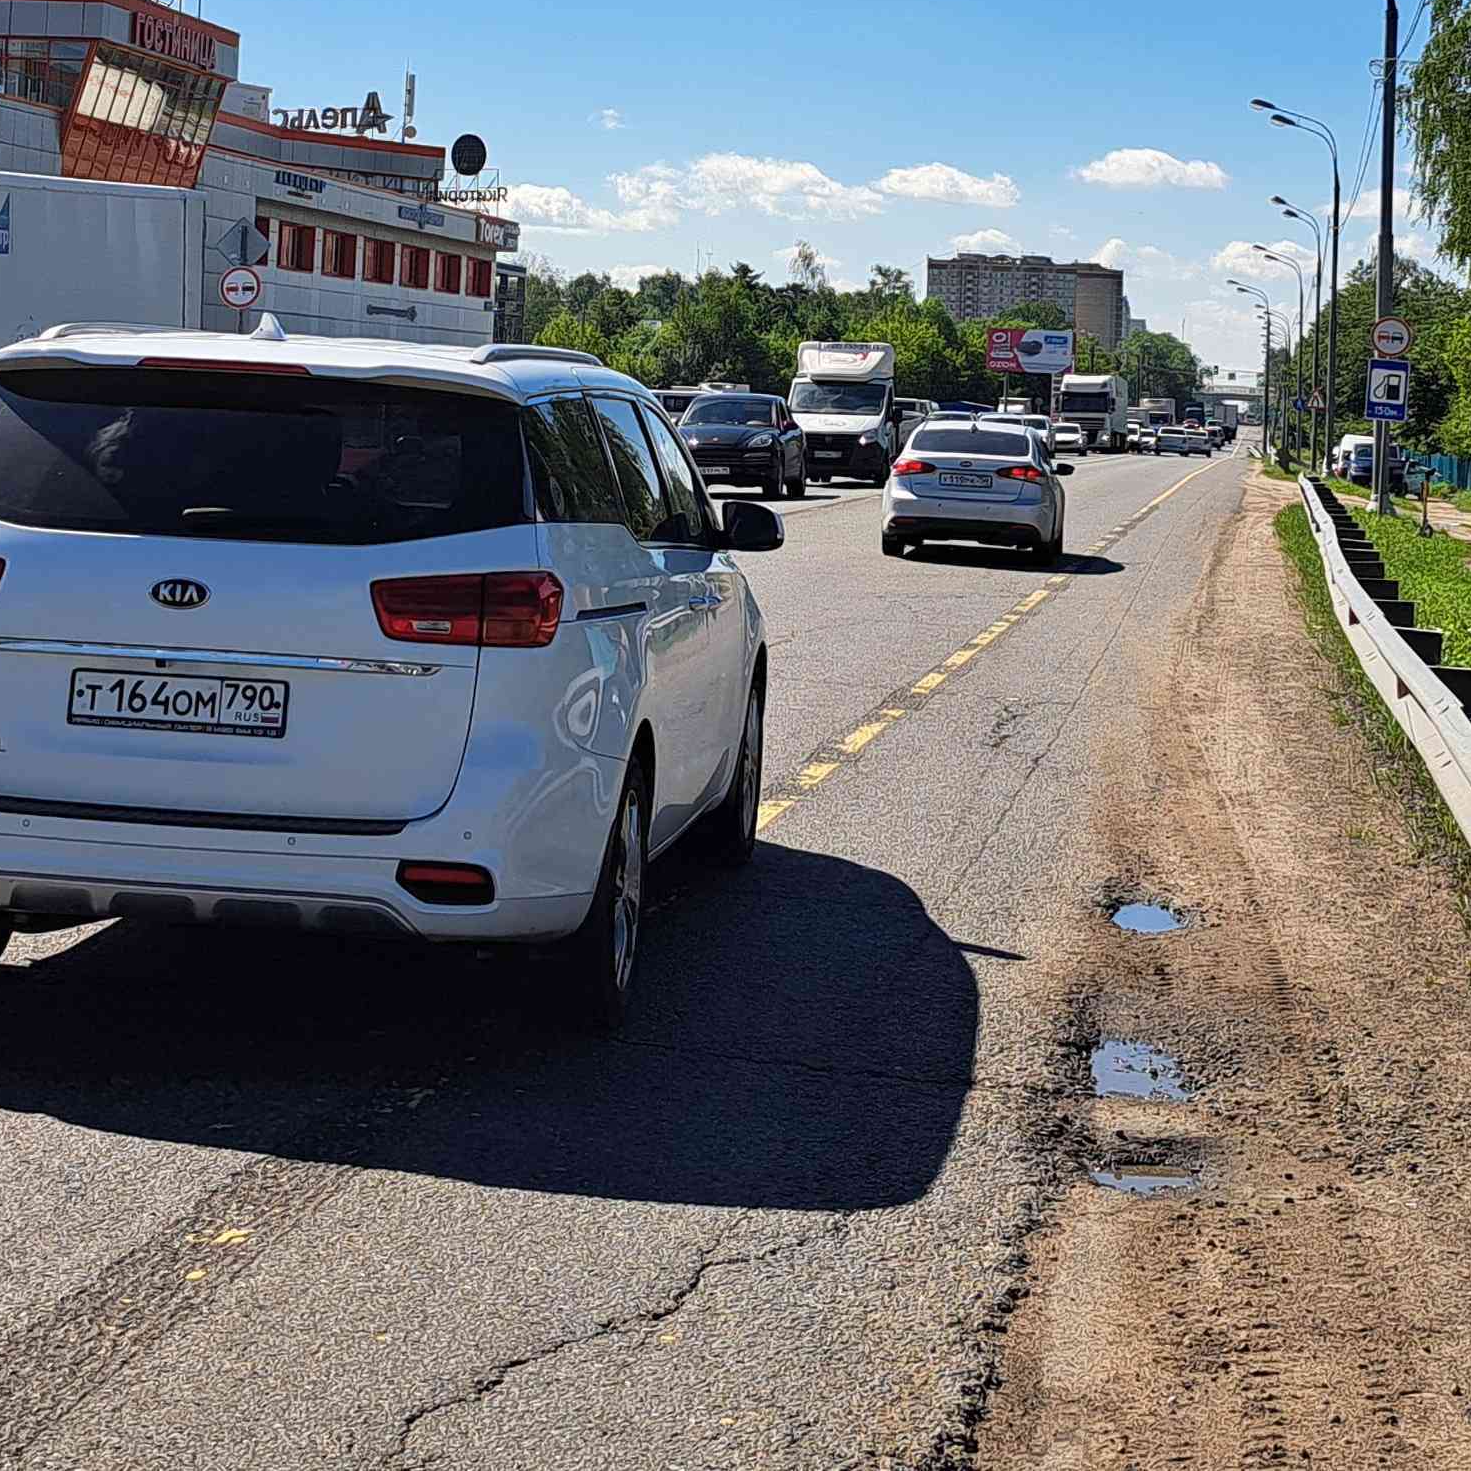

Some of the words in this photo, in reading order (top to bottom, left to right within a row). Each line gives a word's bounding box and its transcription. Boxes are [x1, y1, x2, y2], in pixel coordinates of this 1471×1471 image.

[133, 11, 218, 70] ГОСТИНИЦА
[159, 583, 199, 603] KIA
[234, 710, 260, 723] RUS
